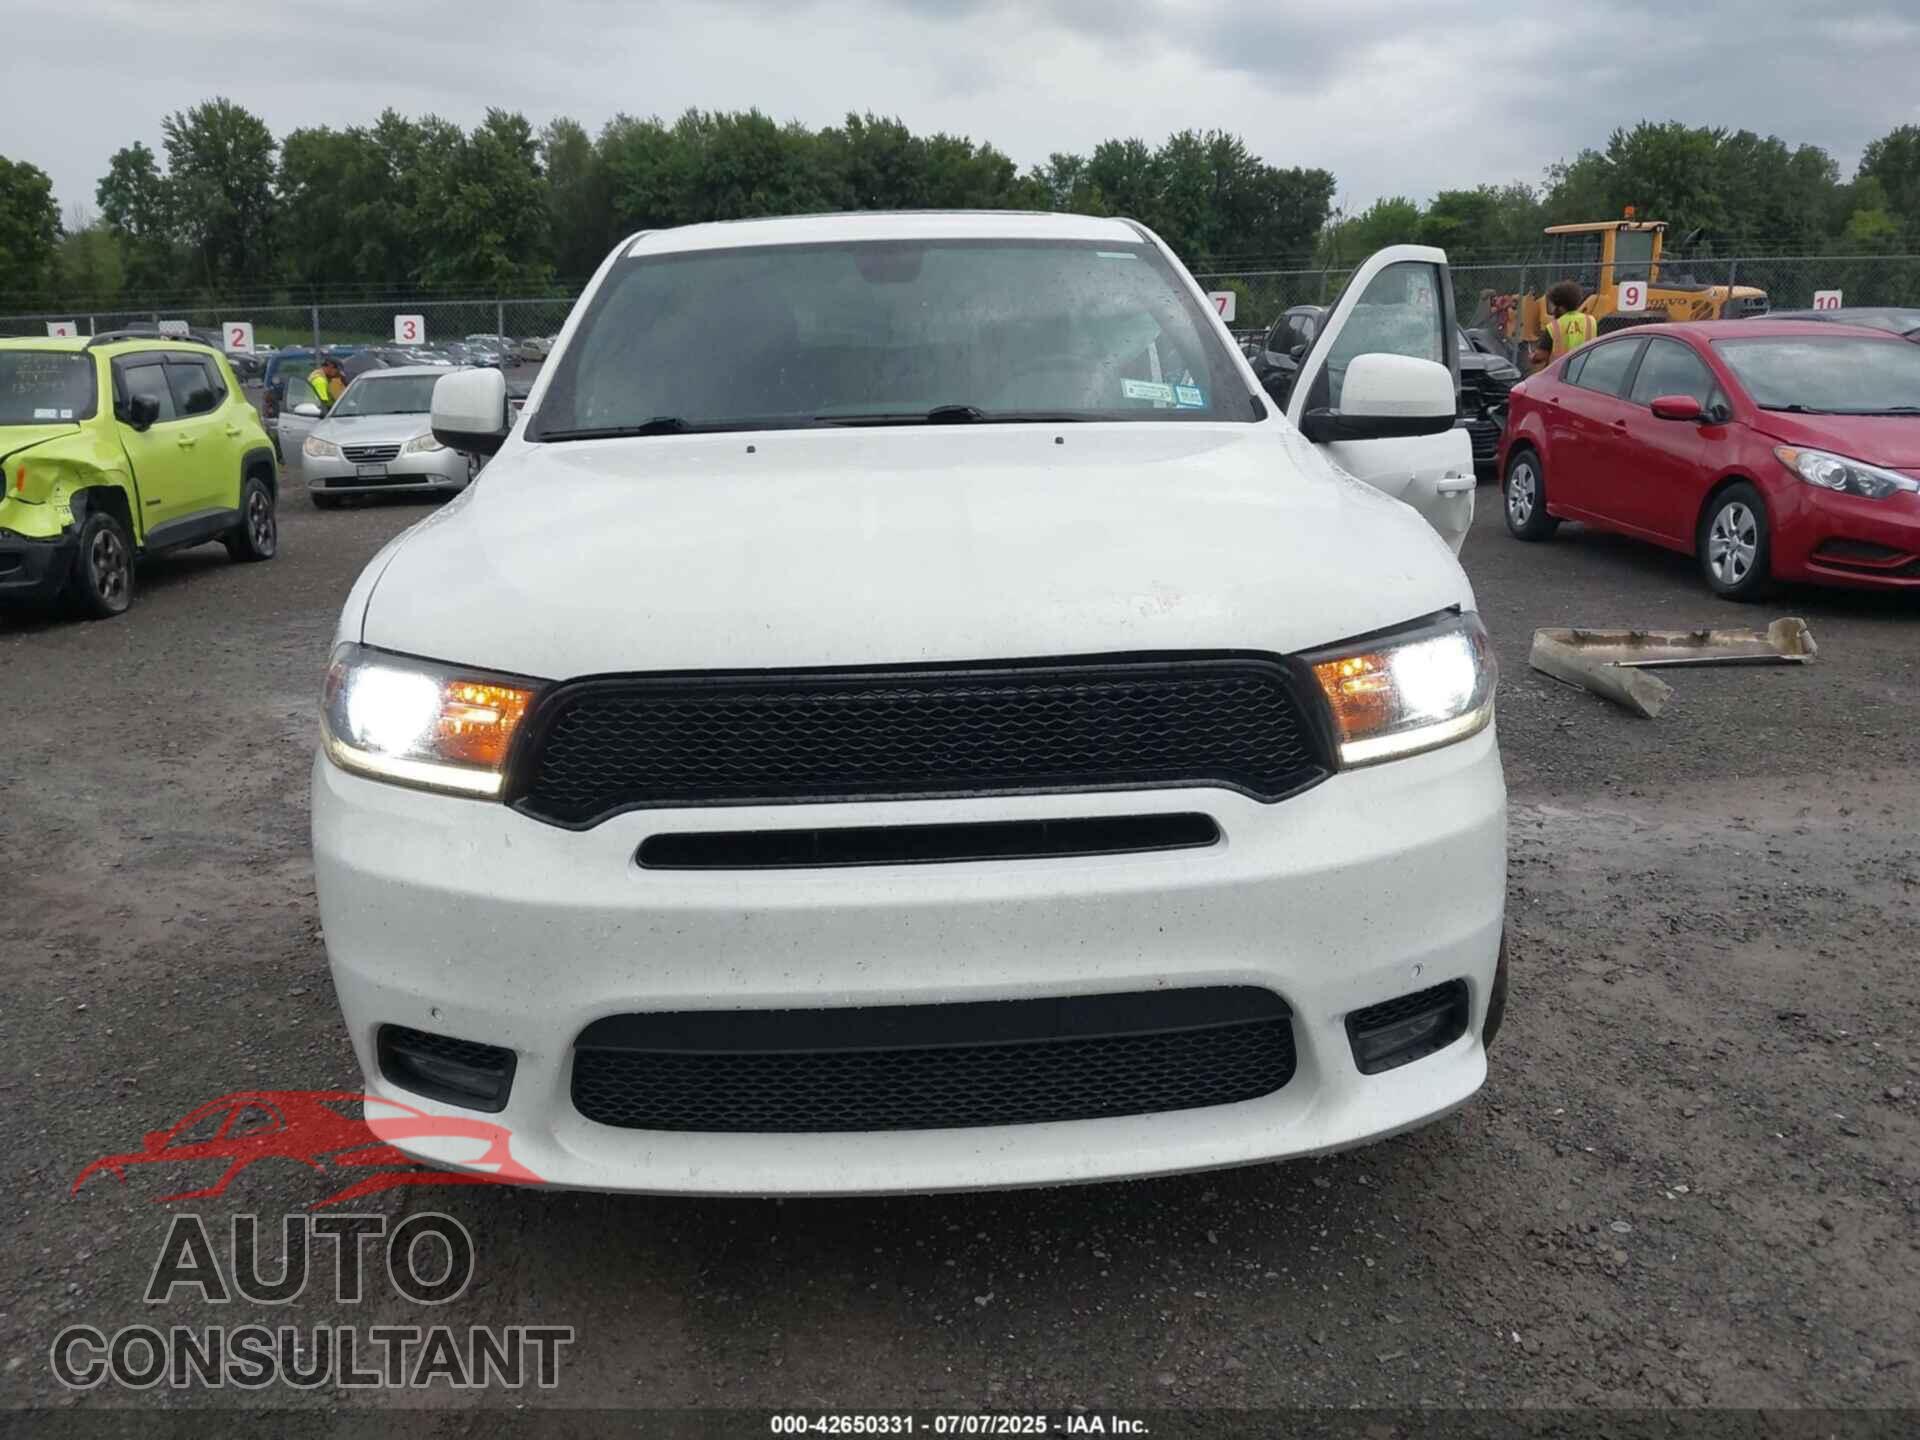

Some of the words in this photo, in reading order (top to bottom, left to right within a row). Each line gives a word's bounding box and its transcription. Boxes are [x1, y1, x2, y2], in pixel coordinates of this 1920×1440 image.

[1625, 286, 1639, 306] 9
[1646, 298, 1687, 307] OLVO
[1816, 296, 1839, 310] 10
[1215, 297, 1227, 316] 7
[231, 328, 246, 348] 2
[403, 320, 416, 340] 3
